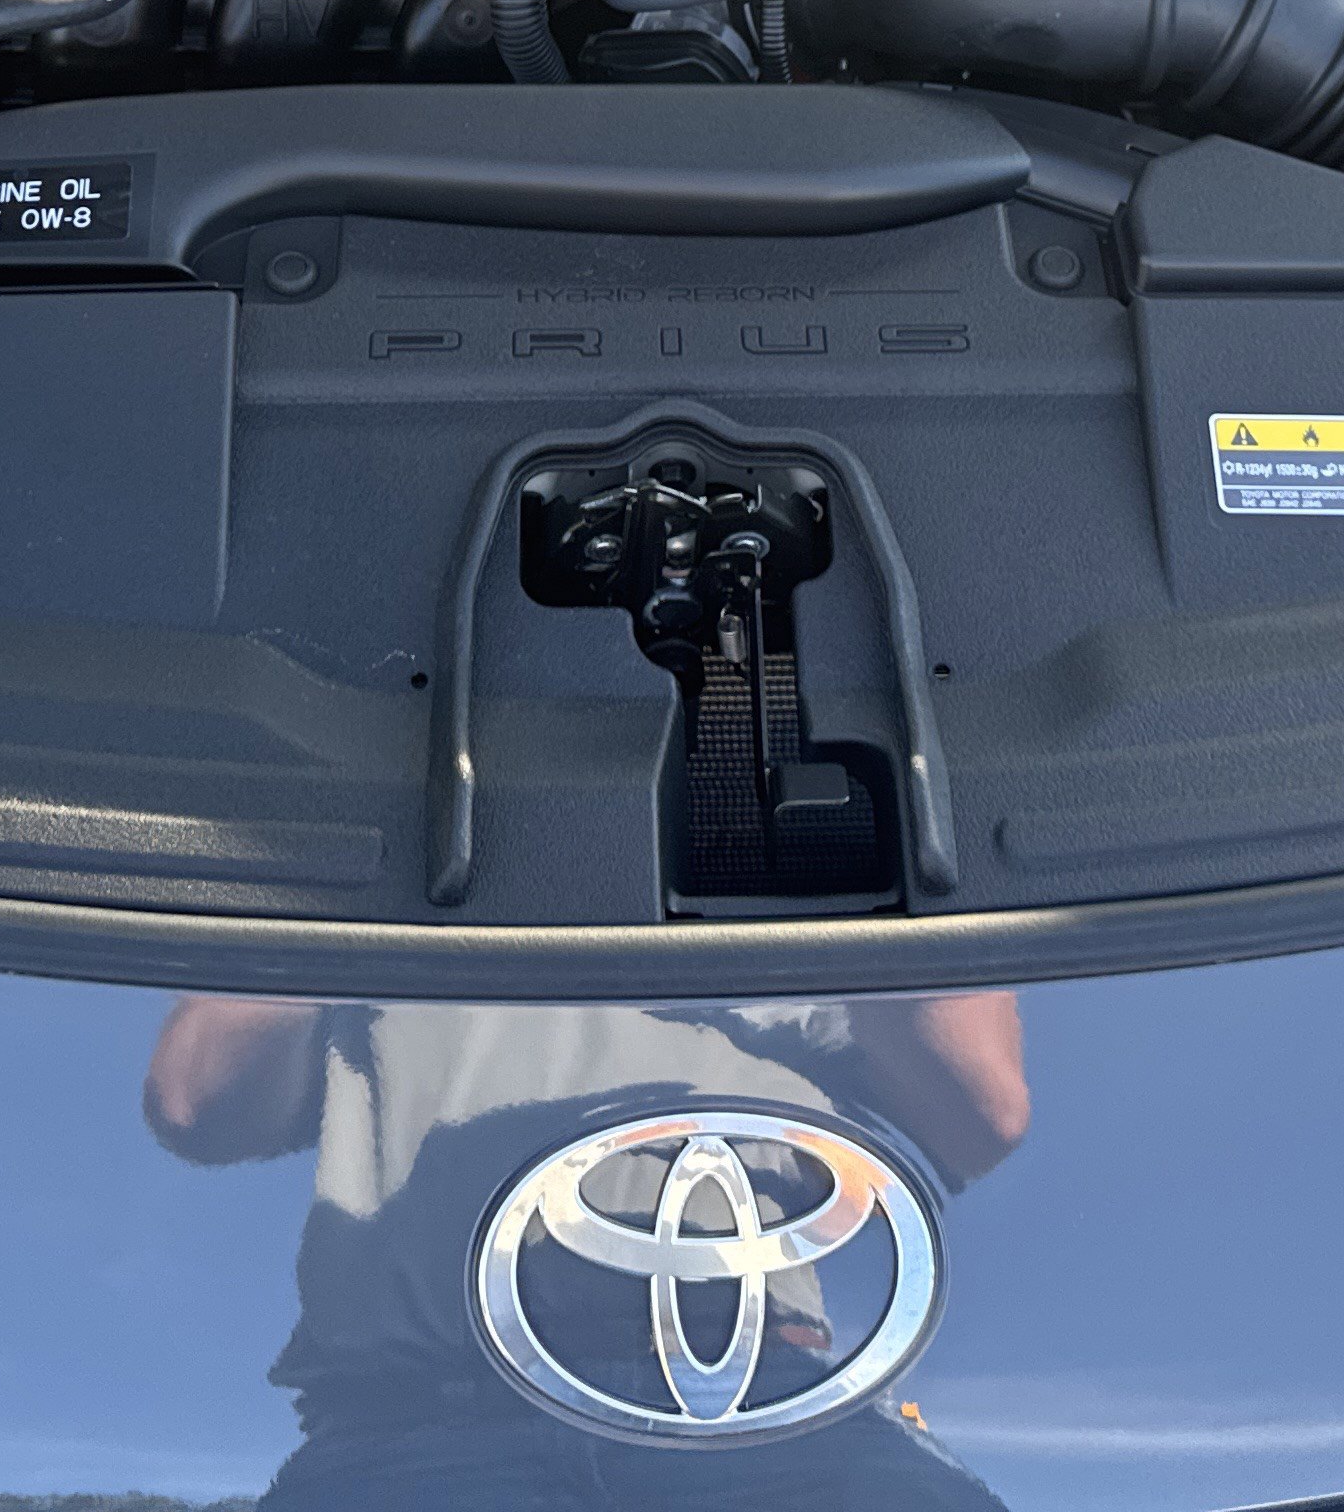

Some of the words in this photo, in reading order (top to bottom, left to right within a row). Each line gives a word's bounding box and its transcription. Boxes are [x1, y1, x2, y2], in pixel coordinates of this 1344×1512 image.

[59, 178, 101, 201] OIL
[20, 206, 92, 231] 0W-8
[516, 288, 647, 304] HYBRID
[667, 287, 815, 303] REBORN
[368, 323, 972, 361] PRIUS
